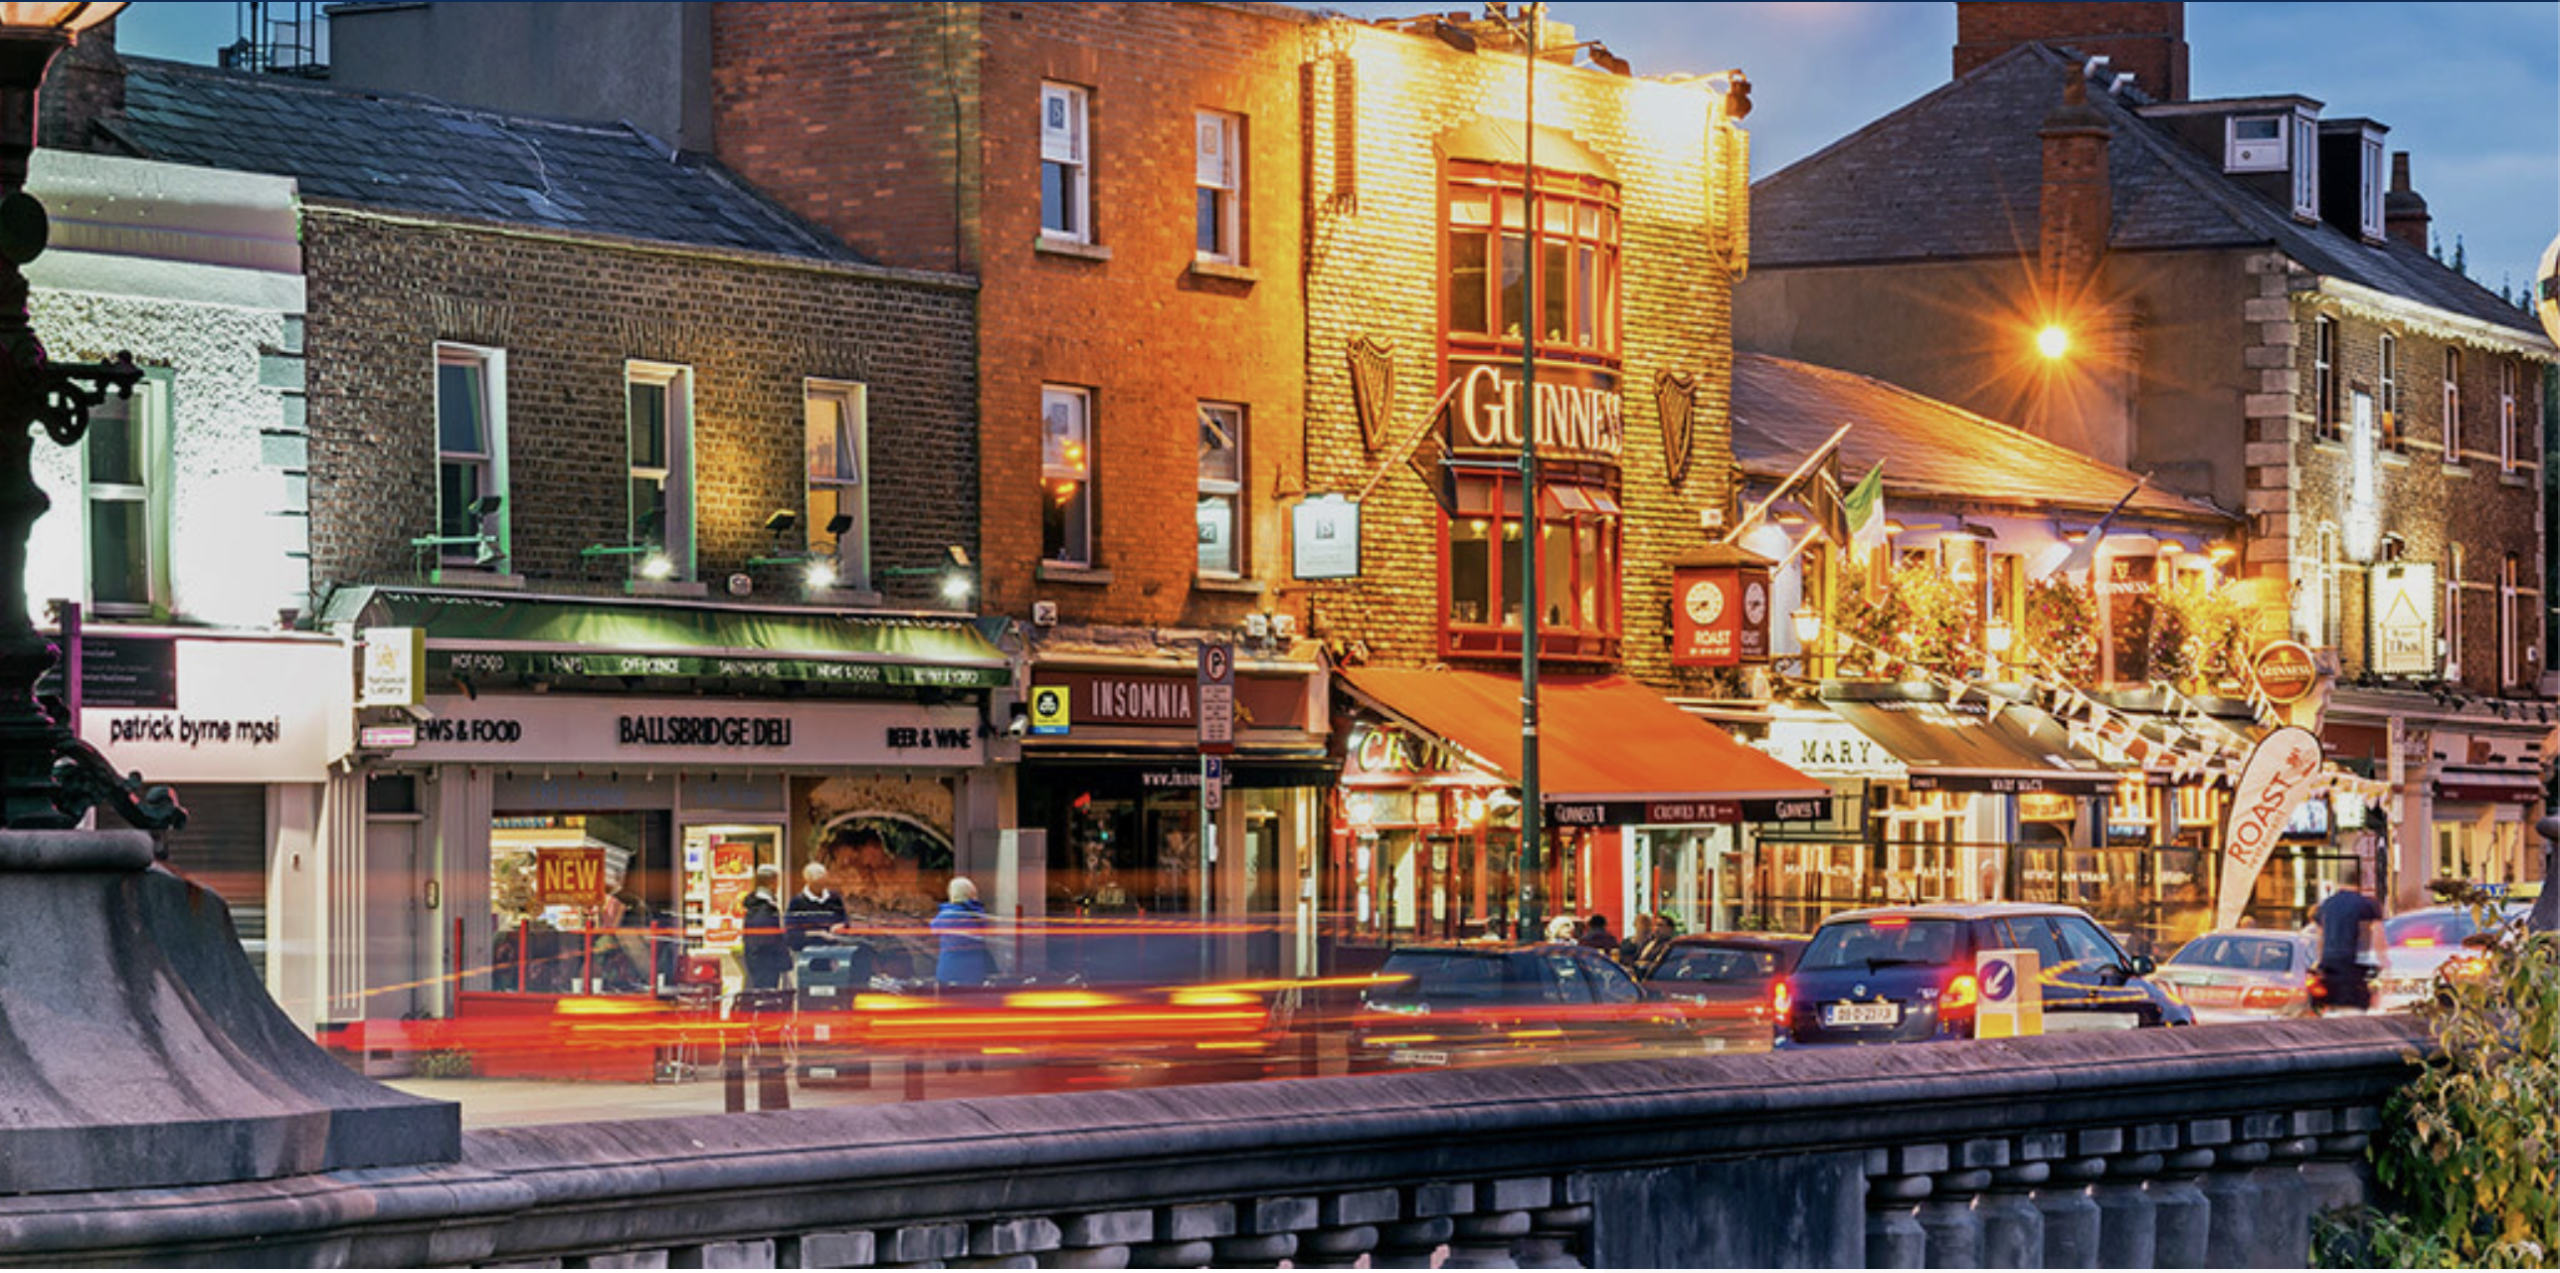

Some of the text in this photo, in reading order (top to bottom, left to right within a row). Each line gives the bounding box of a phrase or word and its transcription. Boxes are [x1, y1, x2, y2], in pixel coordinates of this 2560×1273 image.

[1461, 363, 1623, 455] GUINNESS
[2093, 580, 2150, 595] GUINNESS
[1694, 629, 1732, 646] ROAST
[451, 653, 504, 671] HOT FOOD
[2258, 663, 2311, 679] GUINNESS
[1091, 681, 1192, 719] INSOMNIA
[110, 715, 280, 748] patrick byrne mpsi
[417, 719, 454, 741] EWS
[456, 719, 469, 741] &
[472, 719, 522, 742] FOOD
[618, 715, 792, 746] BALLSBRIDGE DELI
[886, 727, 972, 749] BEER & WINE
[1801, 739, 1872, 764] MARY
[1554, 803, 1596, 823] GUINNESS
[1775, 801, 1812, 819] GUINNESS
[2228, 771, 2292, 865] ROAST
[545, 859, 599, 891] NEW
